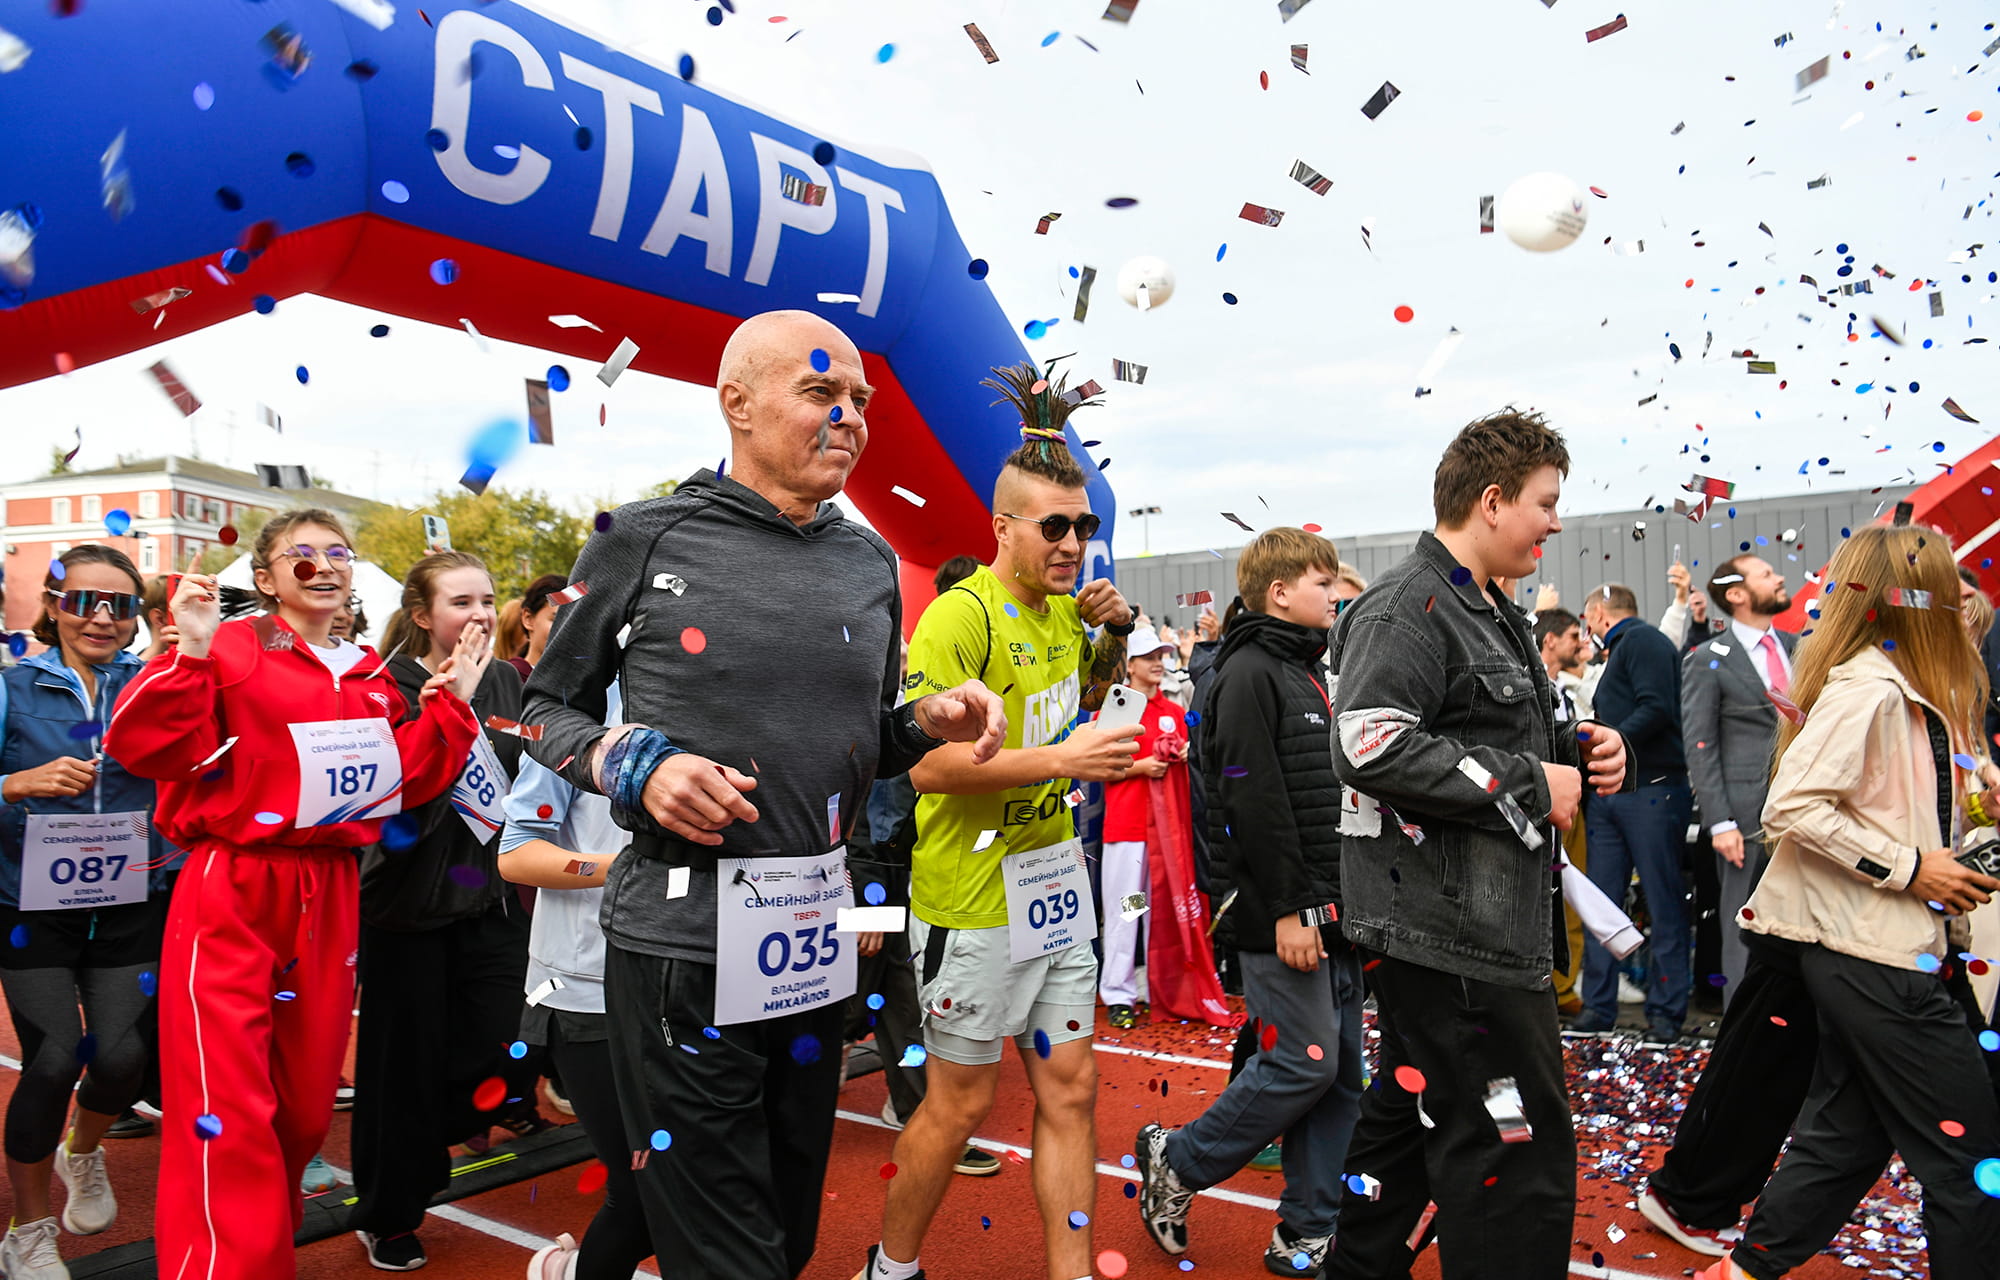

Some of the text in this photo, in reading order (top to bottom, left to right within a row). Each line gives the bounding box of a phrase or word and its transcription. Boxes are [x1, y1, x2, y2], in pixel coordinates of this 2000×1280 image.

[431, 10, 906, 318] СТАРТ
[311, 740, 381, 753] СЕМЕЙНЫЙ ЗАБЕГ
[326, 764, 378, 797] 187
[42, 833, 133, 844] СЕМЕЙНЫЙ ЗАБЕГ
[49, 854, 128, 885] 087
[1018, 864, 1077, 887] СЕМЕЙНЫЙ ЗАБЕГ
[744, 885, 845, 909] СЕМЕЙНЫЙ ЗАБЕГ
[793, 910, 821, 921] ТВЕРЬ
[1028, 889, 1079, 930] 039
[758, 922, 839, 976] 035
[1043, 936, 1072, 951] КАТРИЧ
[770, 976, 827, 996] ВЛАДИМИР
[763, 989, 830, 1012] МИХАЙЛОВ
